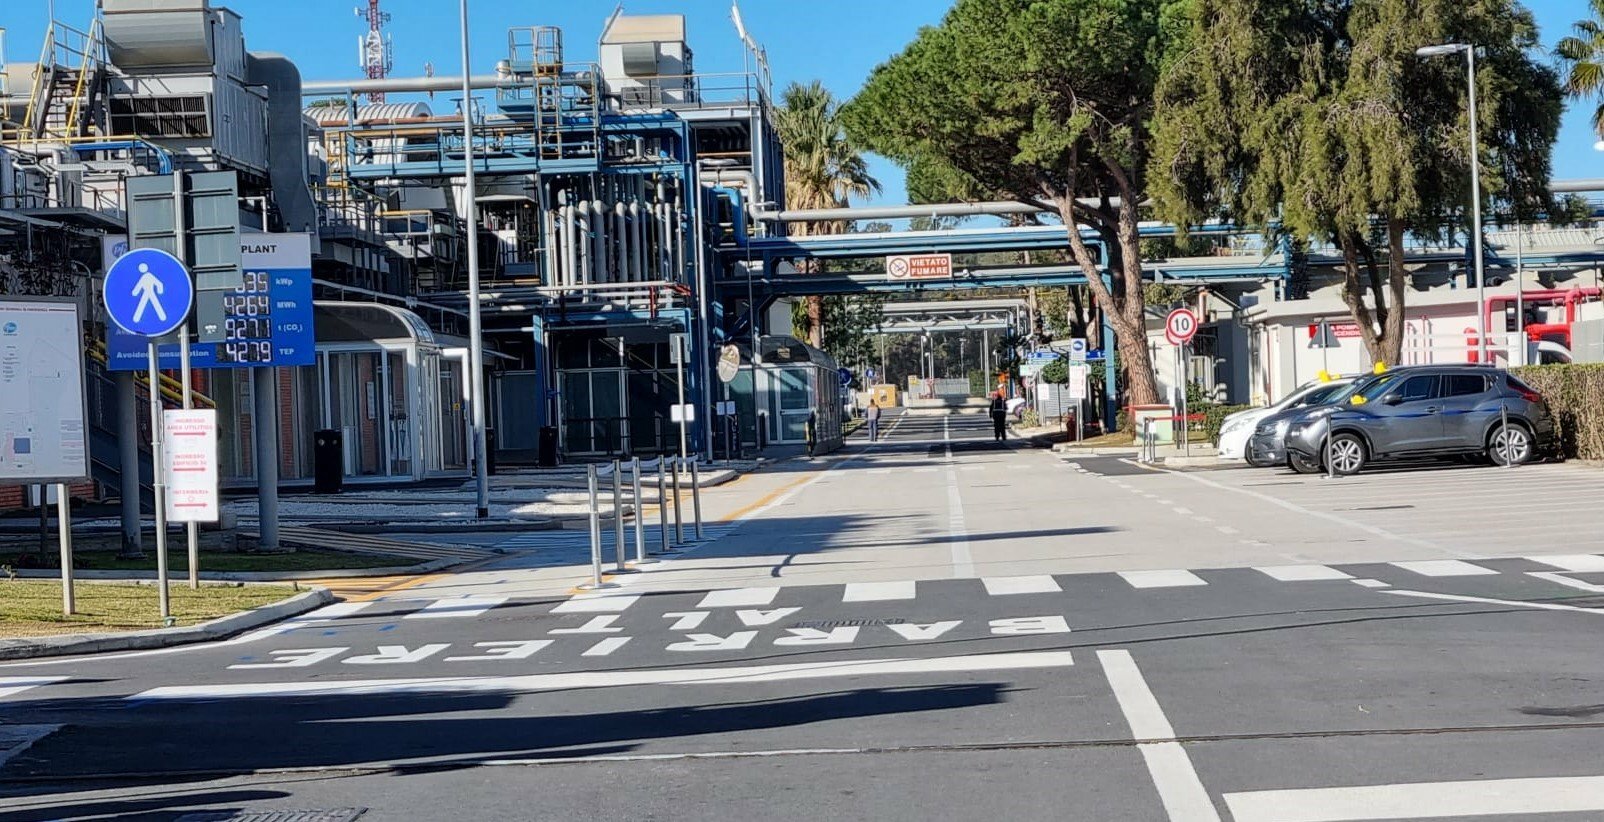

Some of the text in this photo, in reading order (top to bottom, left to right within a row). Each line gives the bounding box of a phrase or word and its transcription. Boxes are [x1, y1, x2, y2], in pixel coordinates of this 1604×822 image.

[241, 245, 278, 254] PLANT
[911, 258, 947, 266] VIETATO
[911, 267, 948, 275] FUMARE
[275, 278, 293, 287] kWp
[224, 295, 269, 316] 4264
[277, 301, 297, 309] MWh
[225, 318, 270, 340] 9271
[1174, 318, 1190, 331] 10
[226, 341, 272, 363] 4279
[547, 606, 804, 635] ALT
[226, 615, 1071, 670] BARRIERE
